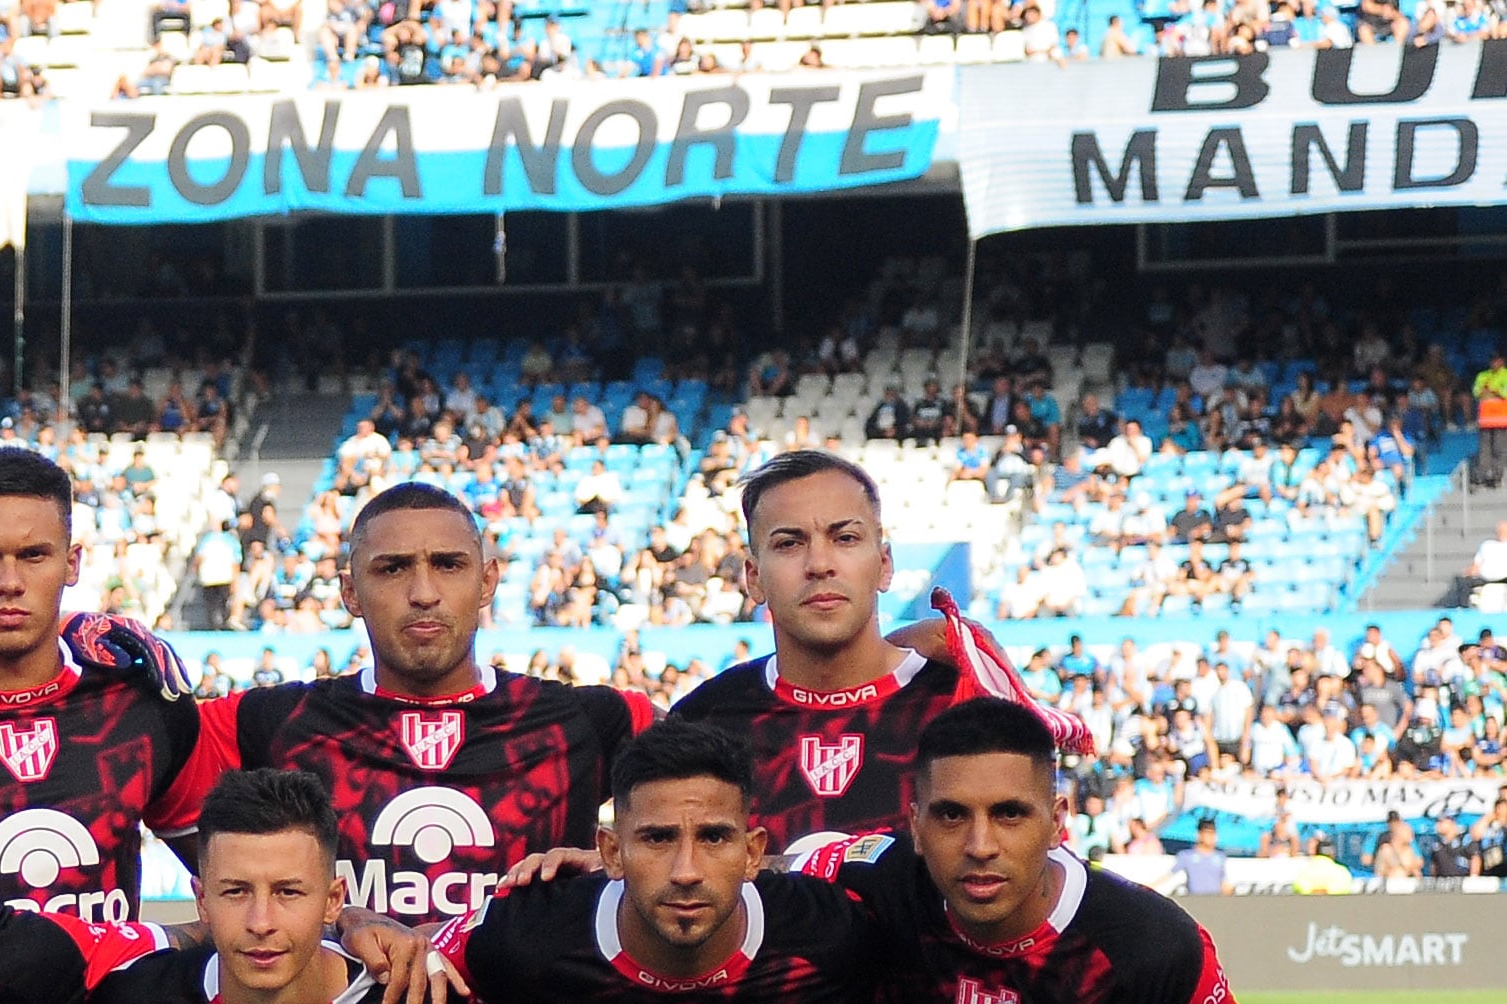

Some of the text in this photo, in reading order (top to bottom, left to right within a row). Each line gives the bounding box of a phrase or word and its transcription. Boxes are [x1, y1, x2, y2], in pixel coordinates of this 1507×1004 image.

[81, 75, 925, 206] ZONA NORTE
[1071, 118, 1507, 204] MAND
[793, 684, 877, 706] GIVOVA
[336, 859, 498, 915] Macr
[1287, 921, 1469, 967] JetSMART
[638, 969, 728, 992] GIVOVA
